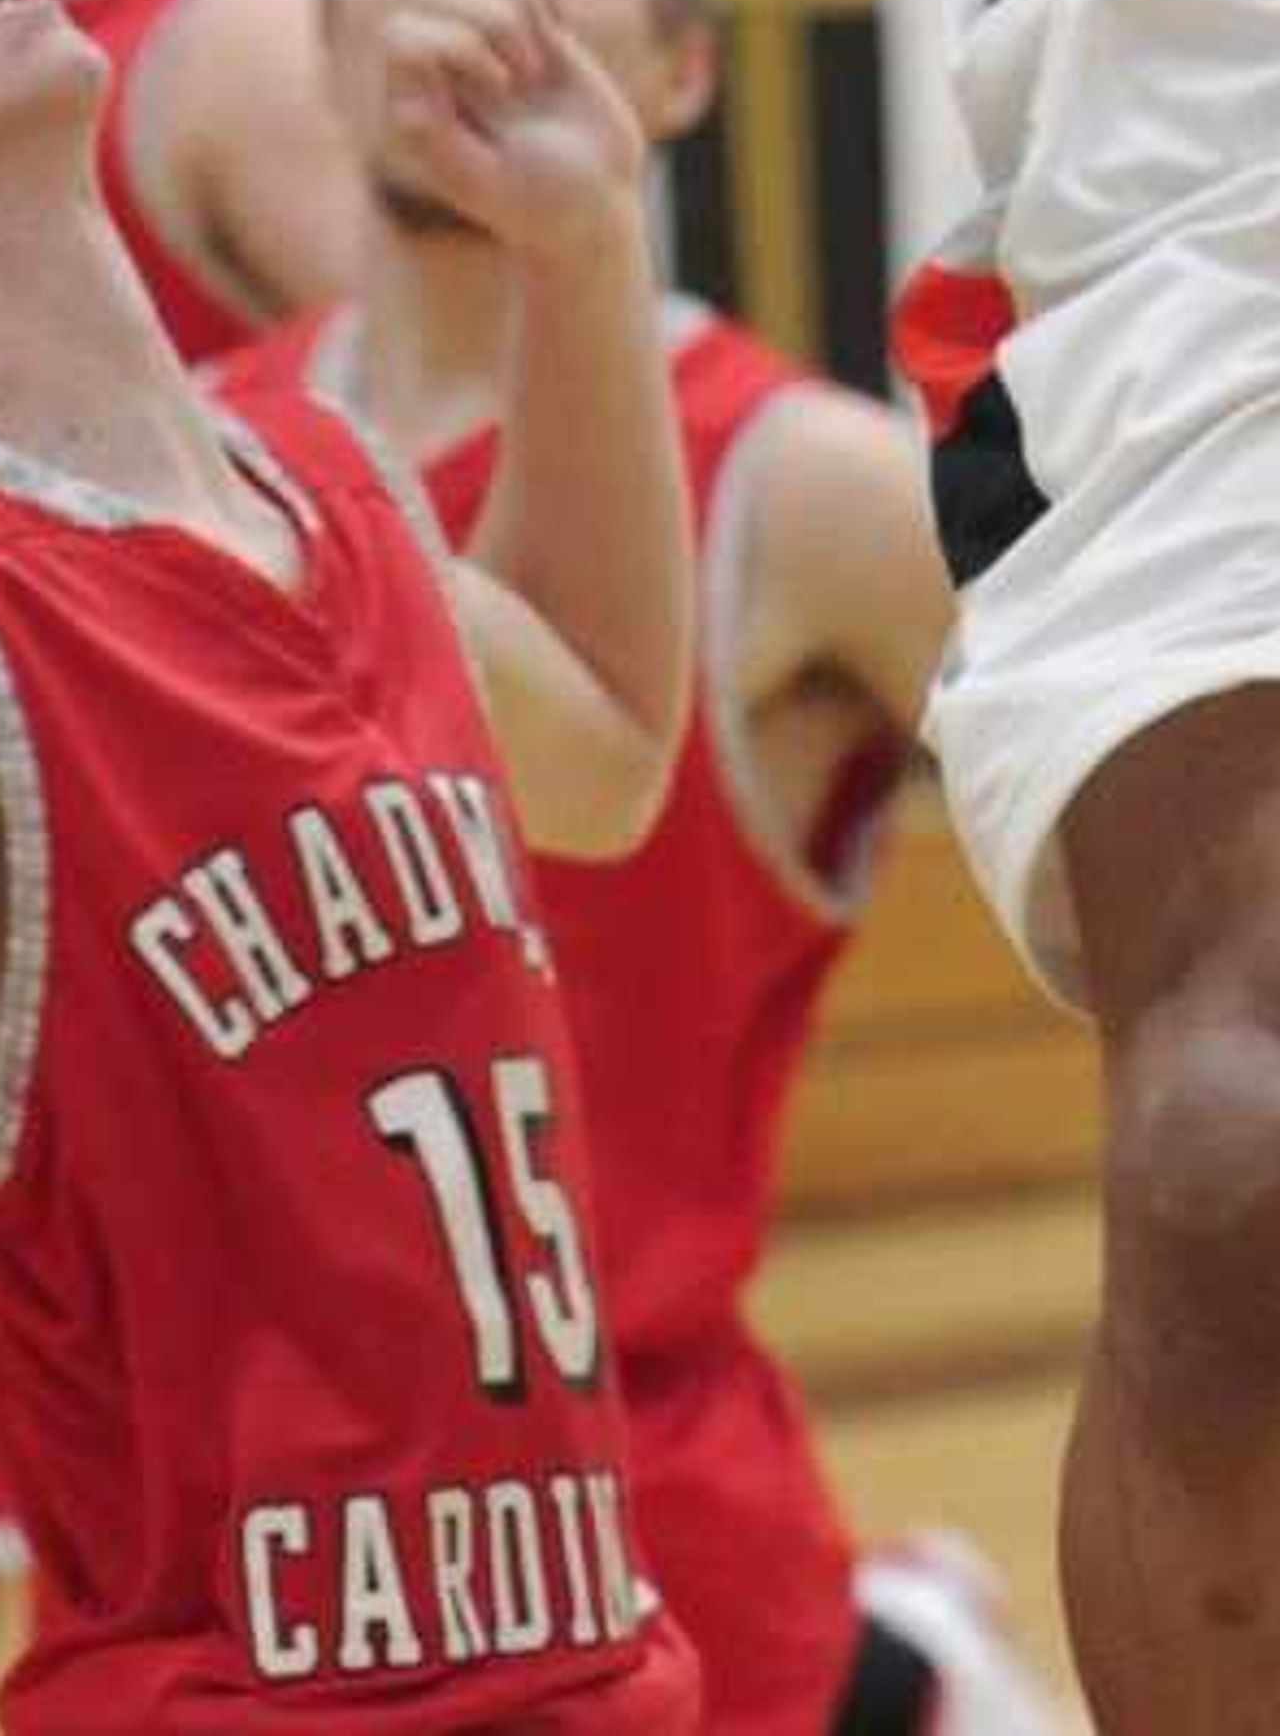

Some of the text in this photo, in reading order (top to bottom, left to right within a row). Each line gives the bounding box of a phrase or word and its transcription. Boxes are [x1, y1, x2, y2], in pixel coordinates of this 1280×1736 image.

[129, 770, 554, 1059] CHADW
[366, 1056, 602, 1395] 15
[240, 1471, 662, 1679] CARDIN
